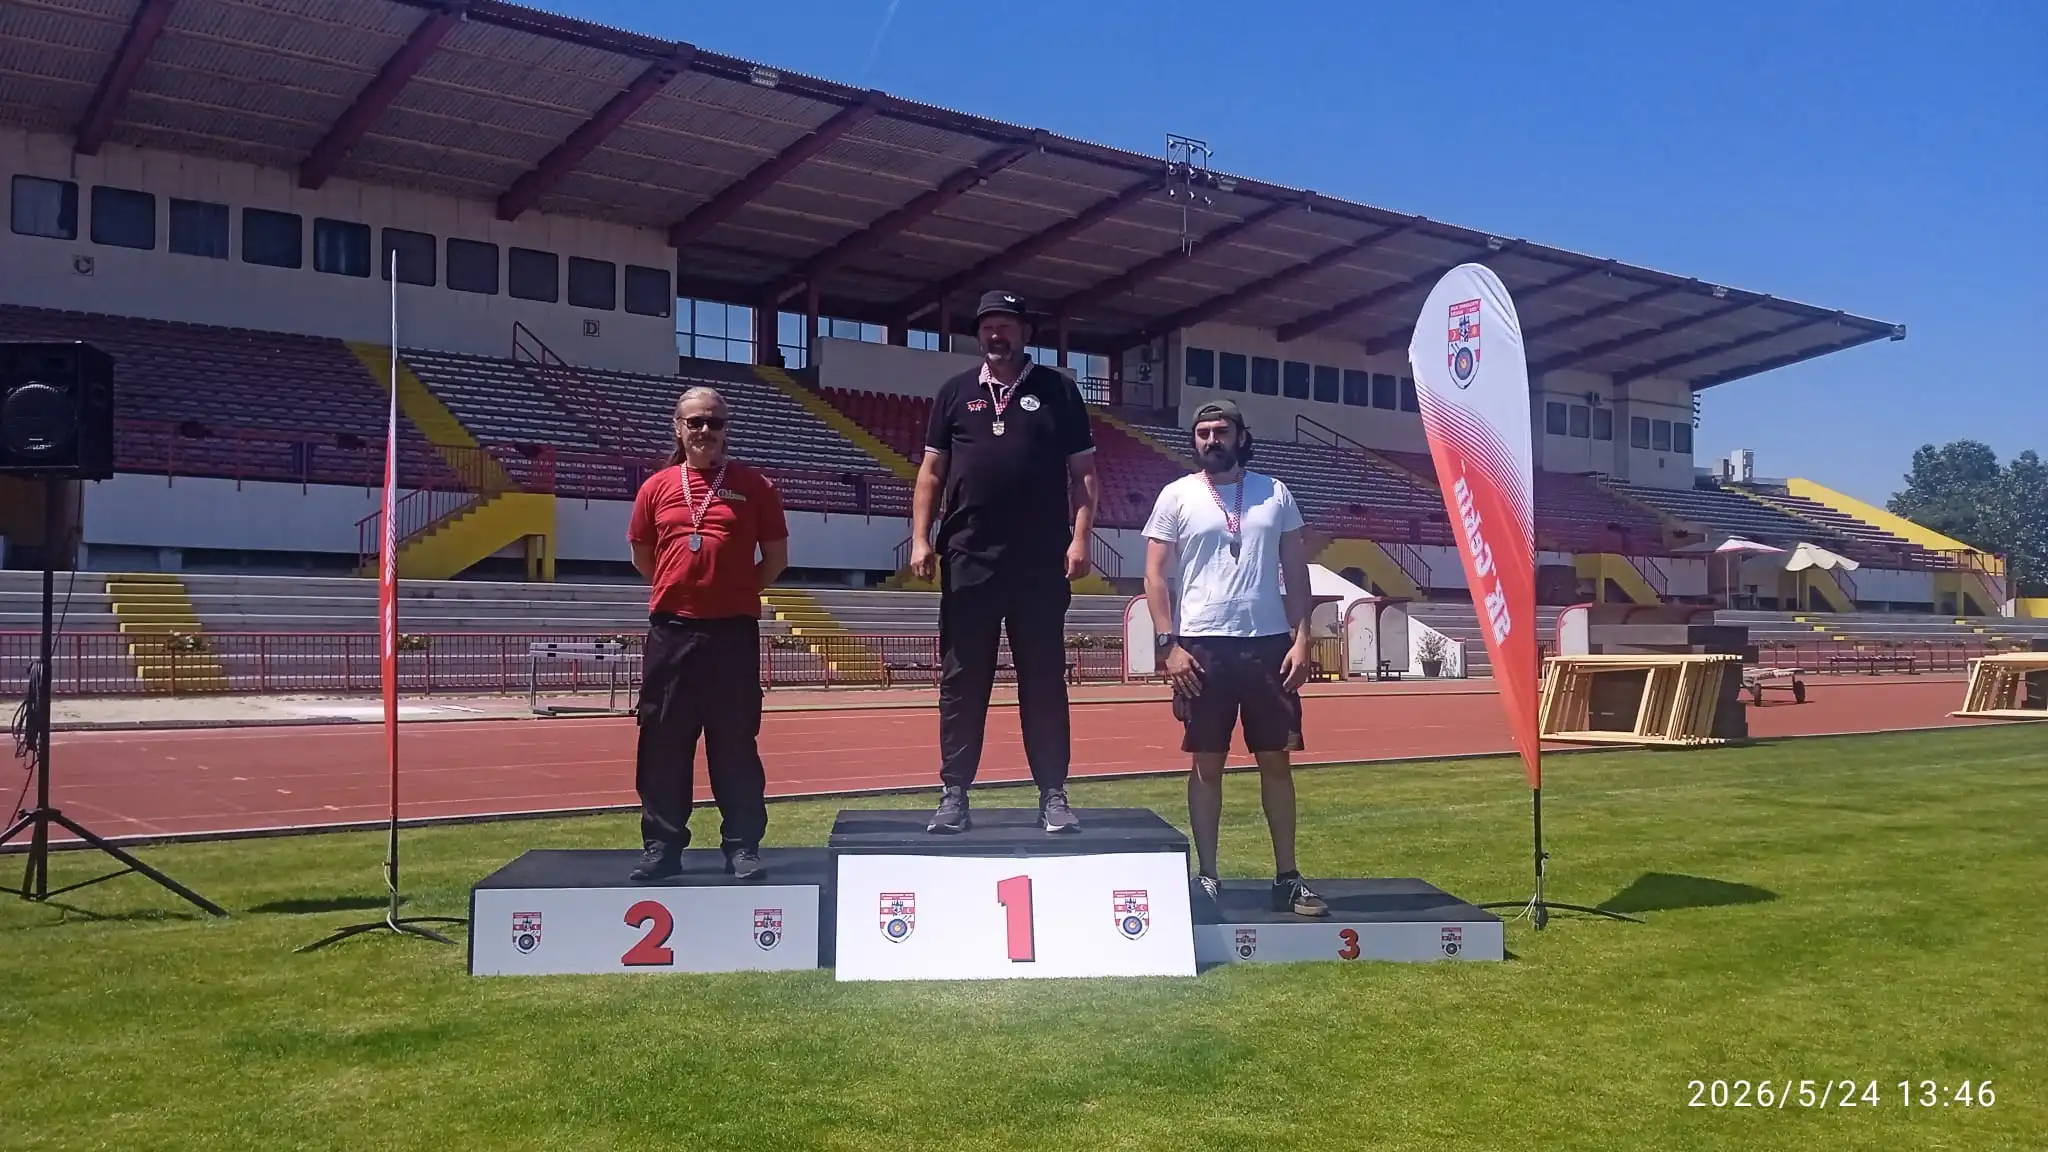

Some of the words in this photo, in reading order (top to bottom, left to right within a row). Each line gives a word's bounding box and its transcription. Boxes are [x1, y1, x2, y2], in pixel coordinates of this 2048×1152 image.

[585, 321, 598, 335] D
[621, 900, 674, 966] 2
[997, 875, 1035, 963] 1
[1337, 928, 1360, 960] 3
